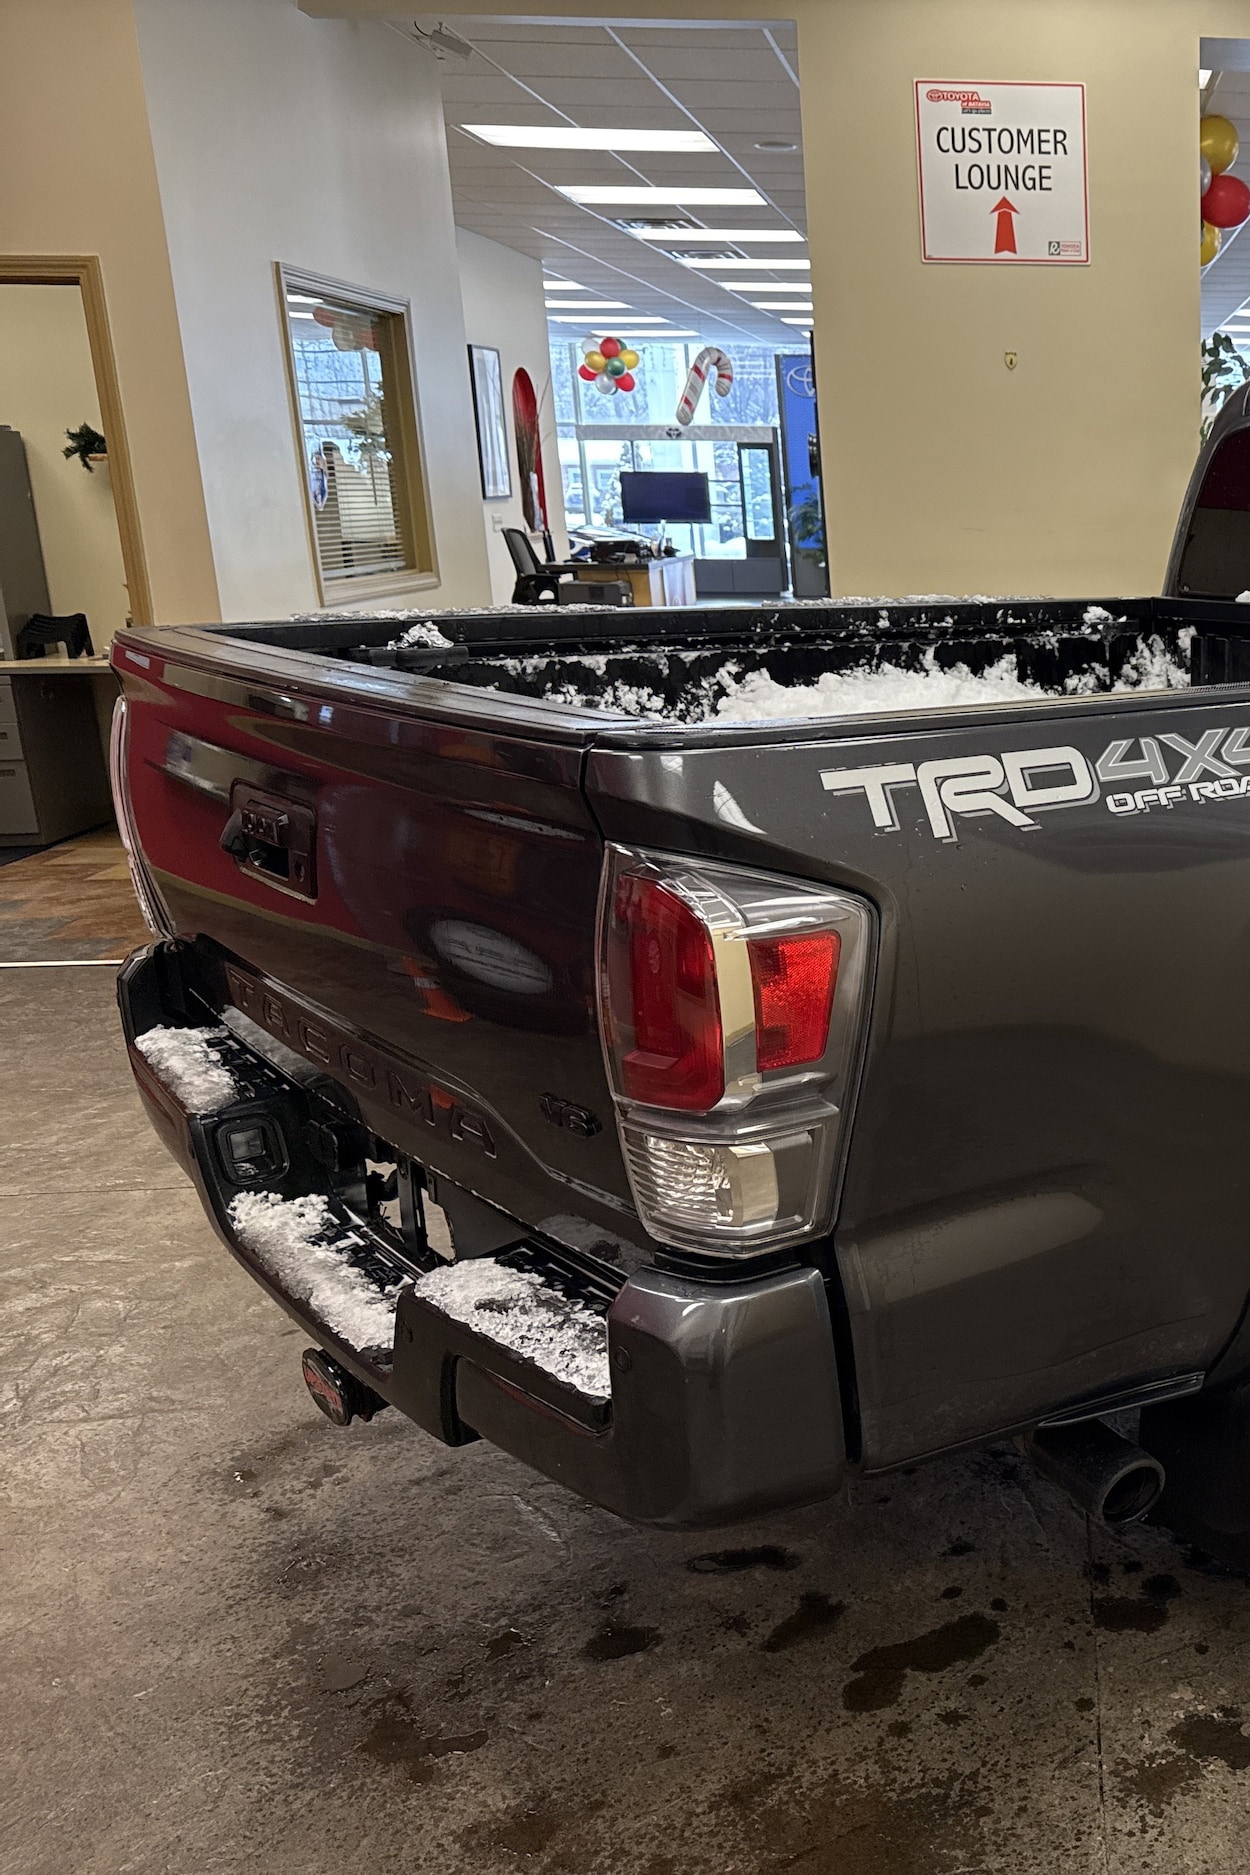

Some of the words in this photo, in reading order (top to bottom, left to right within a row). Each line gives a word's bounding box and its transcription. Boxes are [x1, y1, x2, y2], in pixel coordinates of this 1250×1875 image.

[942, 92, 980, 101] TOYOTA
[936, 127, 1068, 155] CUSTOMER
[954, 163, 1052, 191] LOUNGE
[819, 746, 1096, 841] TRD
[1106, 785, 1184, 814] OFF
[229, 969, 497, 1159] TACOMA
